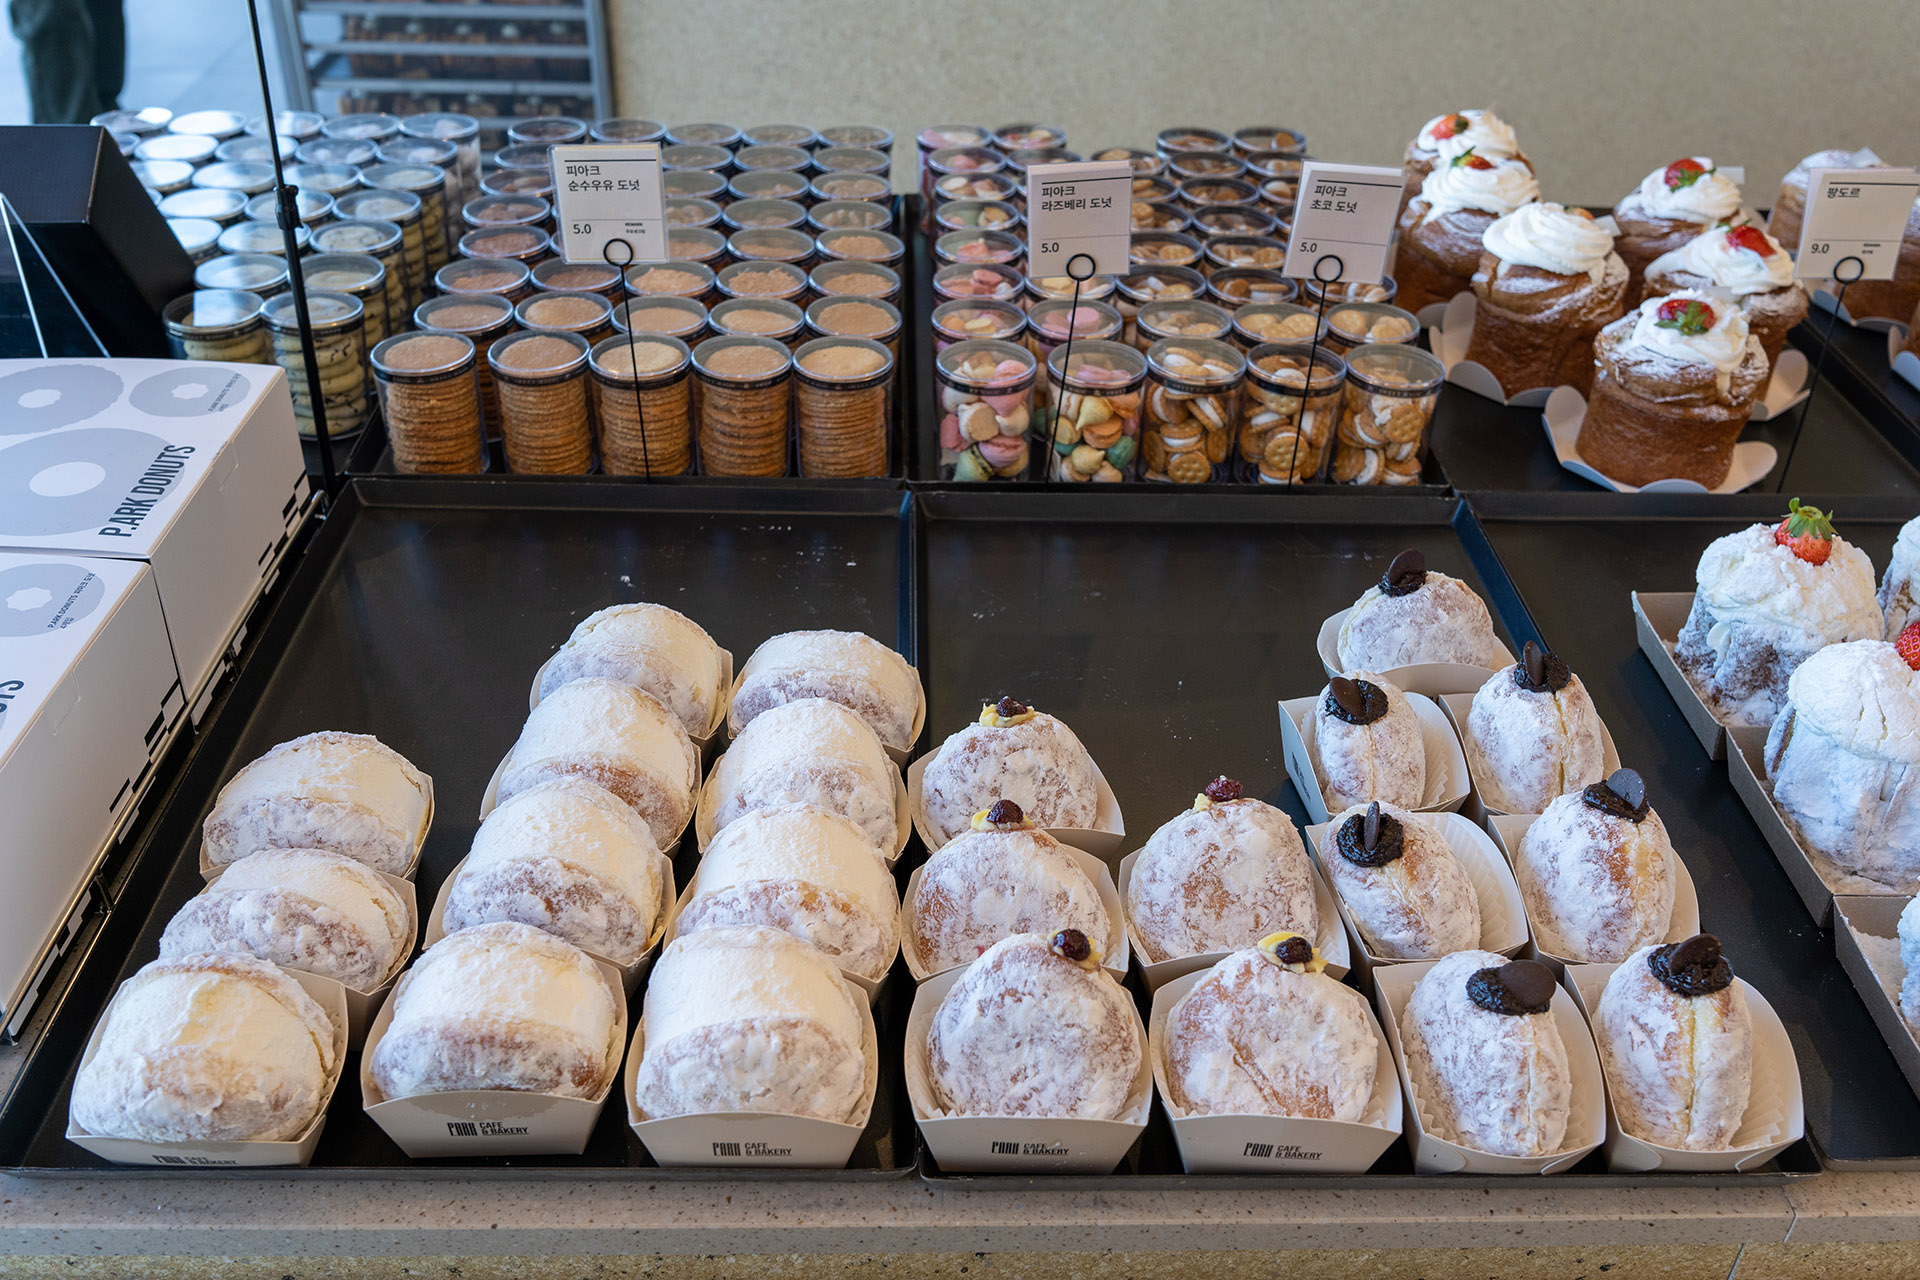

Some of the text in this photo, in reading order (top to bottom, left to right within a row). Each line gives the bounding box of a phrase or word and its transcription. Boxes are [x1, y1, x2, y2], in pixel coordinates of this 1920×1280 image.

[566, 165, 601, 176] 피아크
[568, 179, 640, 192] 순수우유 도넛
[1314, 185, 1348, 197] 피아크
[1042, 186, 1076, 197] 피아크
[1042, 197, 1112, 211] 라즈베리 도넛
[1310, 200, 1357, 214] 초코 도넛
[573, 224, 592, 234] 5.0
[1041, 242, 1059, 253] 5.0
[1299, 242, 1317, 253] 5.0
[1811, 243, 1829, 254] 9.0
[98, 445, 196, 537] P.ARK DONUTS
[491, 1127, 528, 1135] BAKERY
